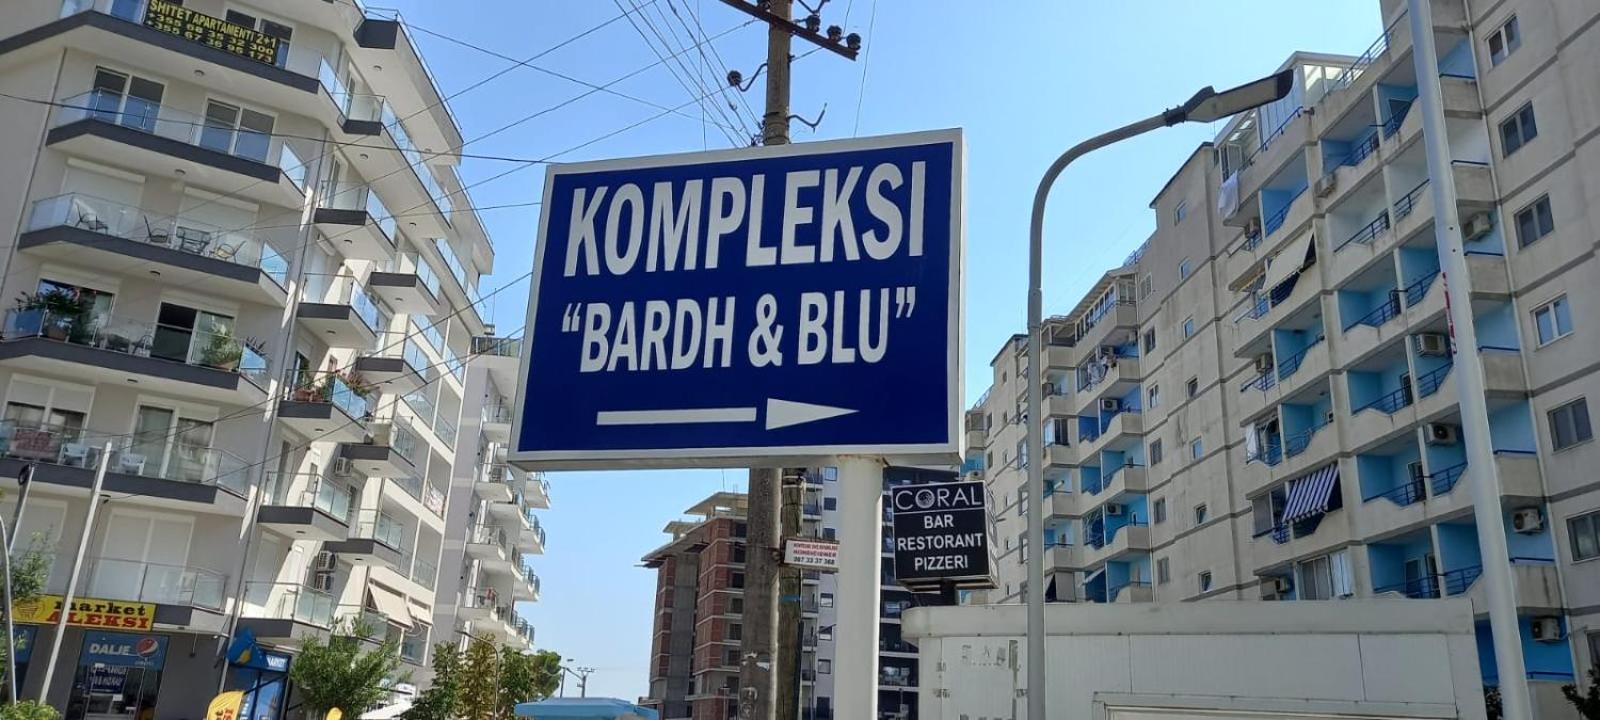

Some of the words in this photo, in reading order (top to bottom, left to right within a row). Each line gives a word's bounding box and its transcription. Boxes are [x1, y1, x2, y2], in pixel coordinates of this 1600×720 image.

[149, 0, 193, 21] SHITET
[191, 14, 255, 41] APARTAMENTI
[256, 33, 277, 49] 2+1
[250, 42, 275, 55] 300
[250, 50, 273, 63] 173
[563, 160, 926, 278] KOMPLEKSI
[748, 293, 784, 368] &
[895, 485, 982, 511] CORAL
[923, 514, 954, 529] BAR
[897, 532, 983, 551] RESTORANT
[914, 554, 968, 571] PIZZERI
[54, 601, 146, 616] market
[46, 611, 149, 629] ALEKSI
[89, 643, 131, 656] DALJE
